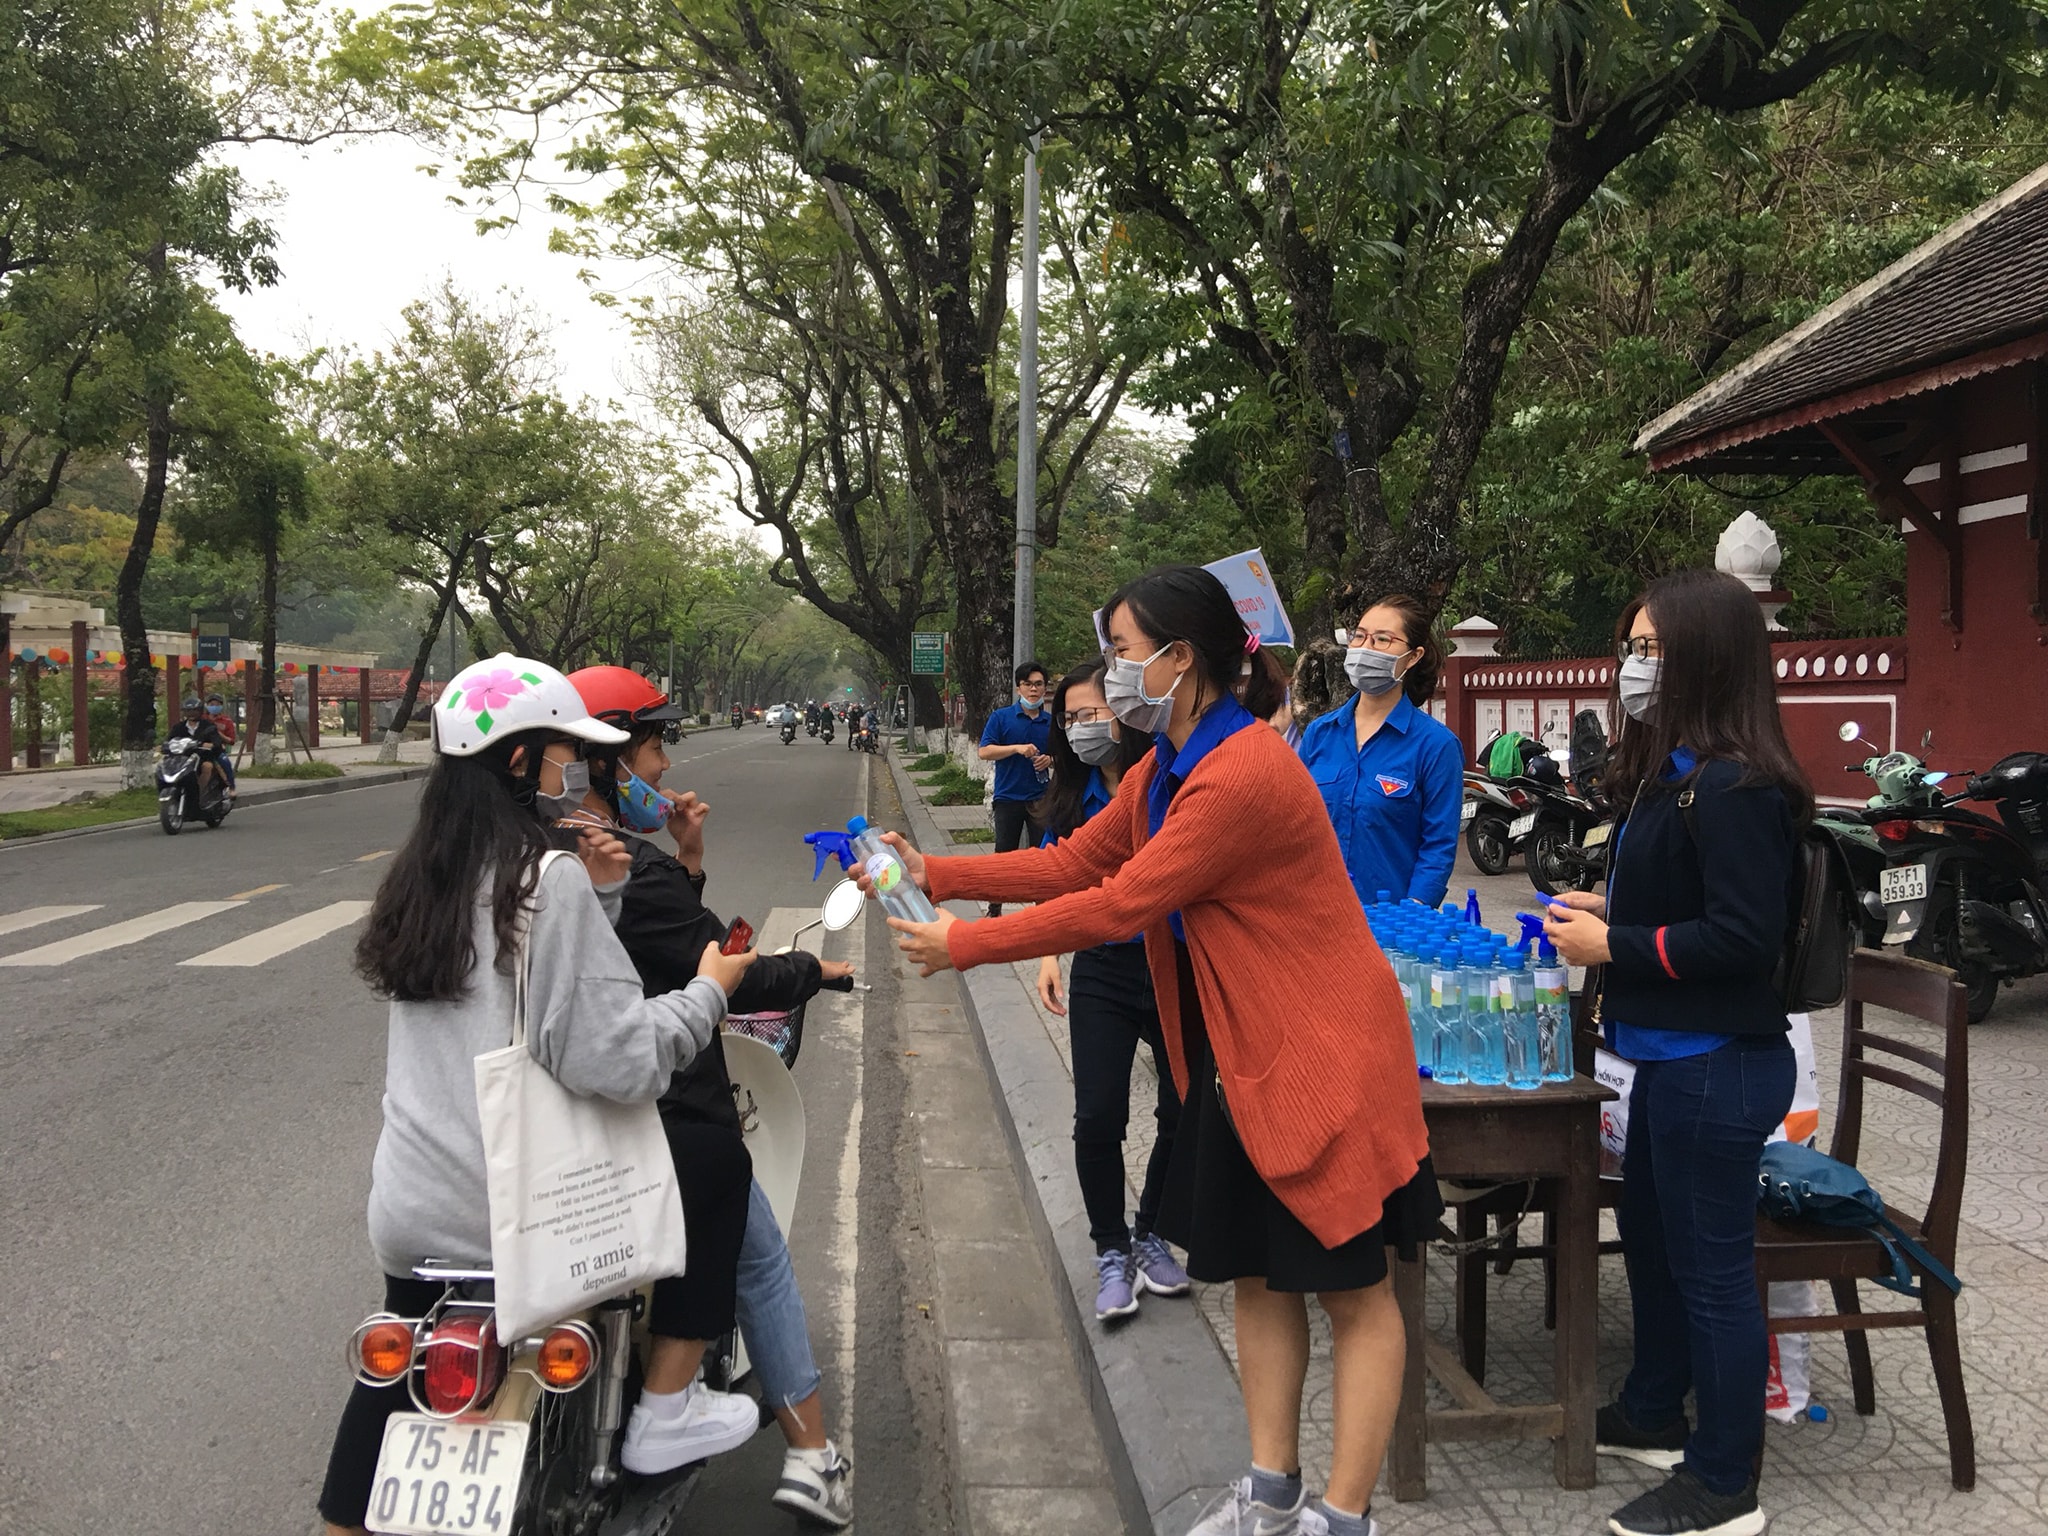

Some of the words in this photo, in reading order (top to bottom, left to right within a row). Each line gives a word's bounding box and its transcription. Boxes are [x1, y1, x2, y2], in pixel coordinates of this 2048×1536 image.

[1887, 867, 1918, 885] 75-F1
[1883, 882, 1923, 901] 359.33
[582, 1265, 627, 1291] depound
[405, 1424, 505, 1475] 75-AF
[377, 1477, 502, 1532] 018.34
